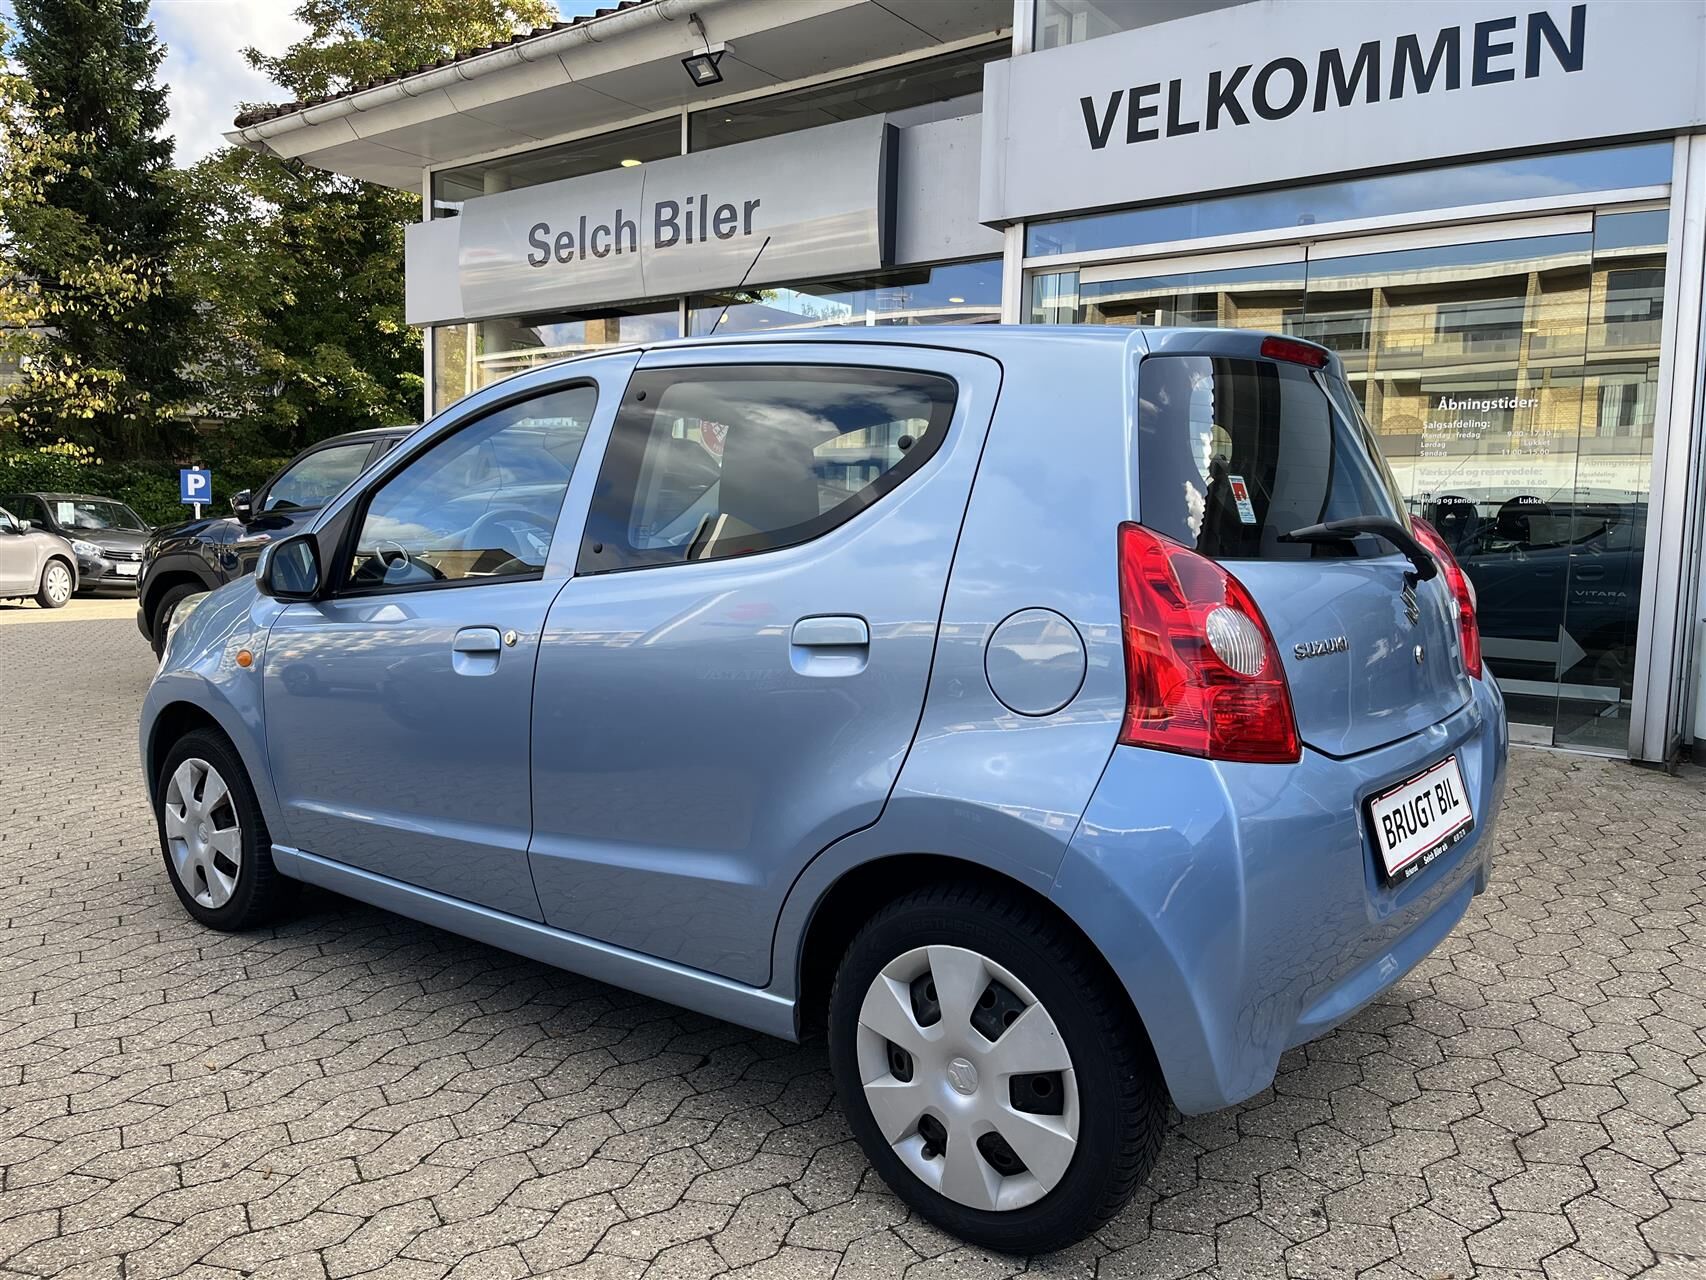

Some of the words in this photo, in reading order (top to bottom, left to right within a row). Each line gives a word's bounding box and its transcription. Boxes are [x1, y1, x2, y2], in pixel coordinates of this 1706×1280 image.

[1080, 4, 1587, 150] VELKOMMEN
[527, 209, 637, 268] Selch
[654, 194, 760, 249] Biler
[1438, 396, 1538, 412] Åbningstider:
[1422, 419, 1490, 430] Salgsafdeling:
[1456, 431, 1481, 440] fredag
[1420, 441, 1446, 449] Lørdag
[1466, 469, 1479, 477] og
[187, 473, 206, 496] P
[1442, 498, 1453, 506] og
[1294, 636, 1349, 660] SUZUKI
[1382, 790, 1435, 850] BRUGT
[1434, 778, 1459, 816] BIL
